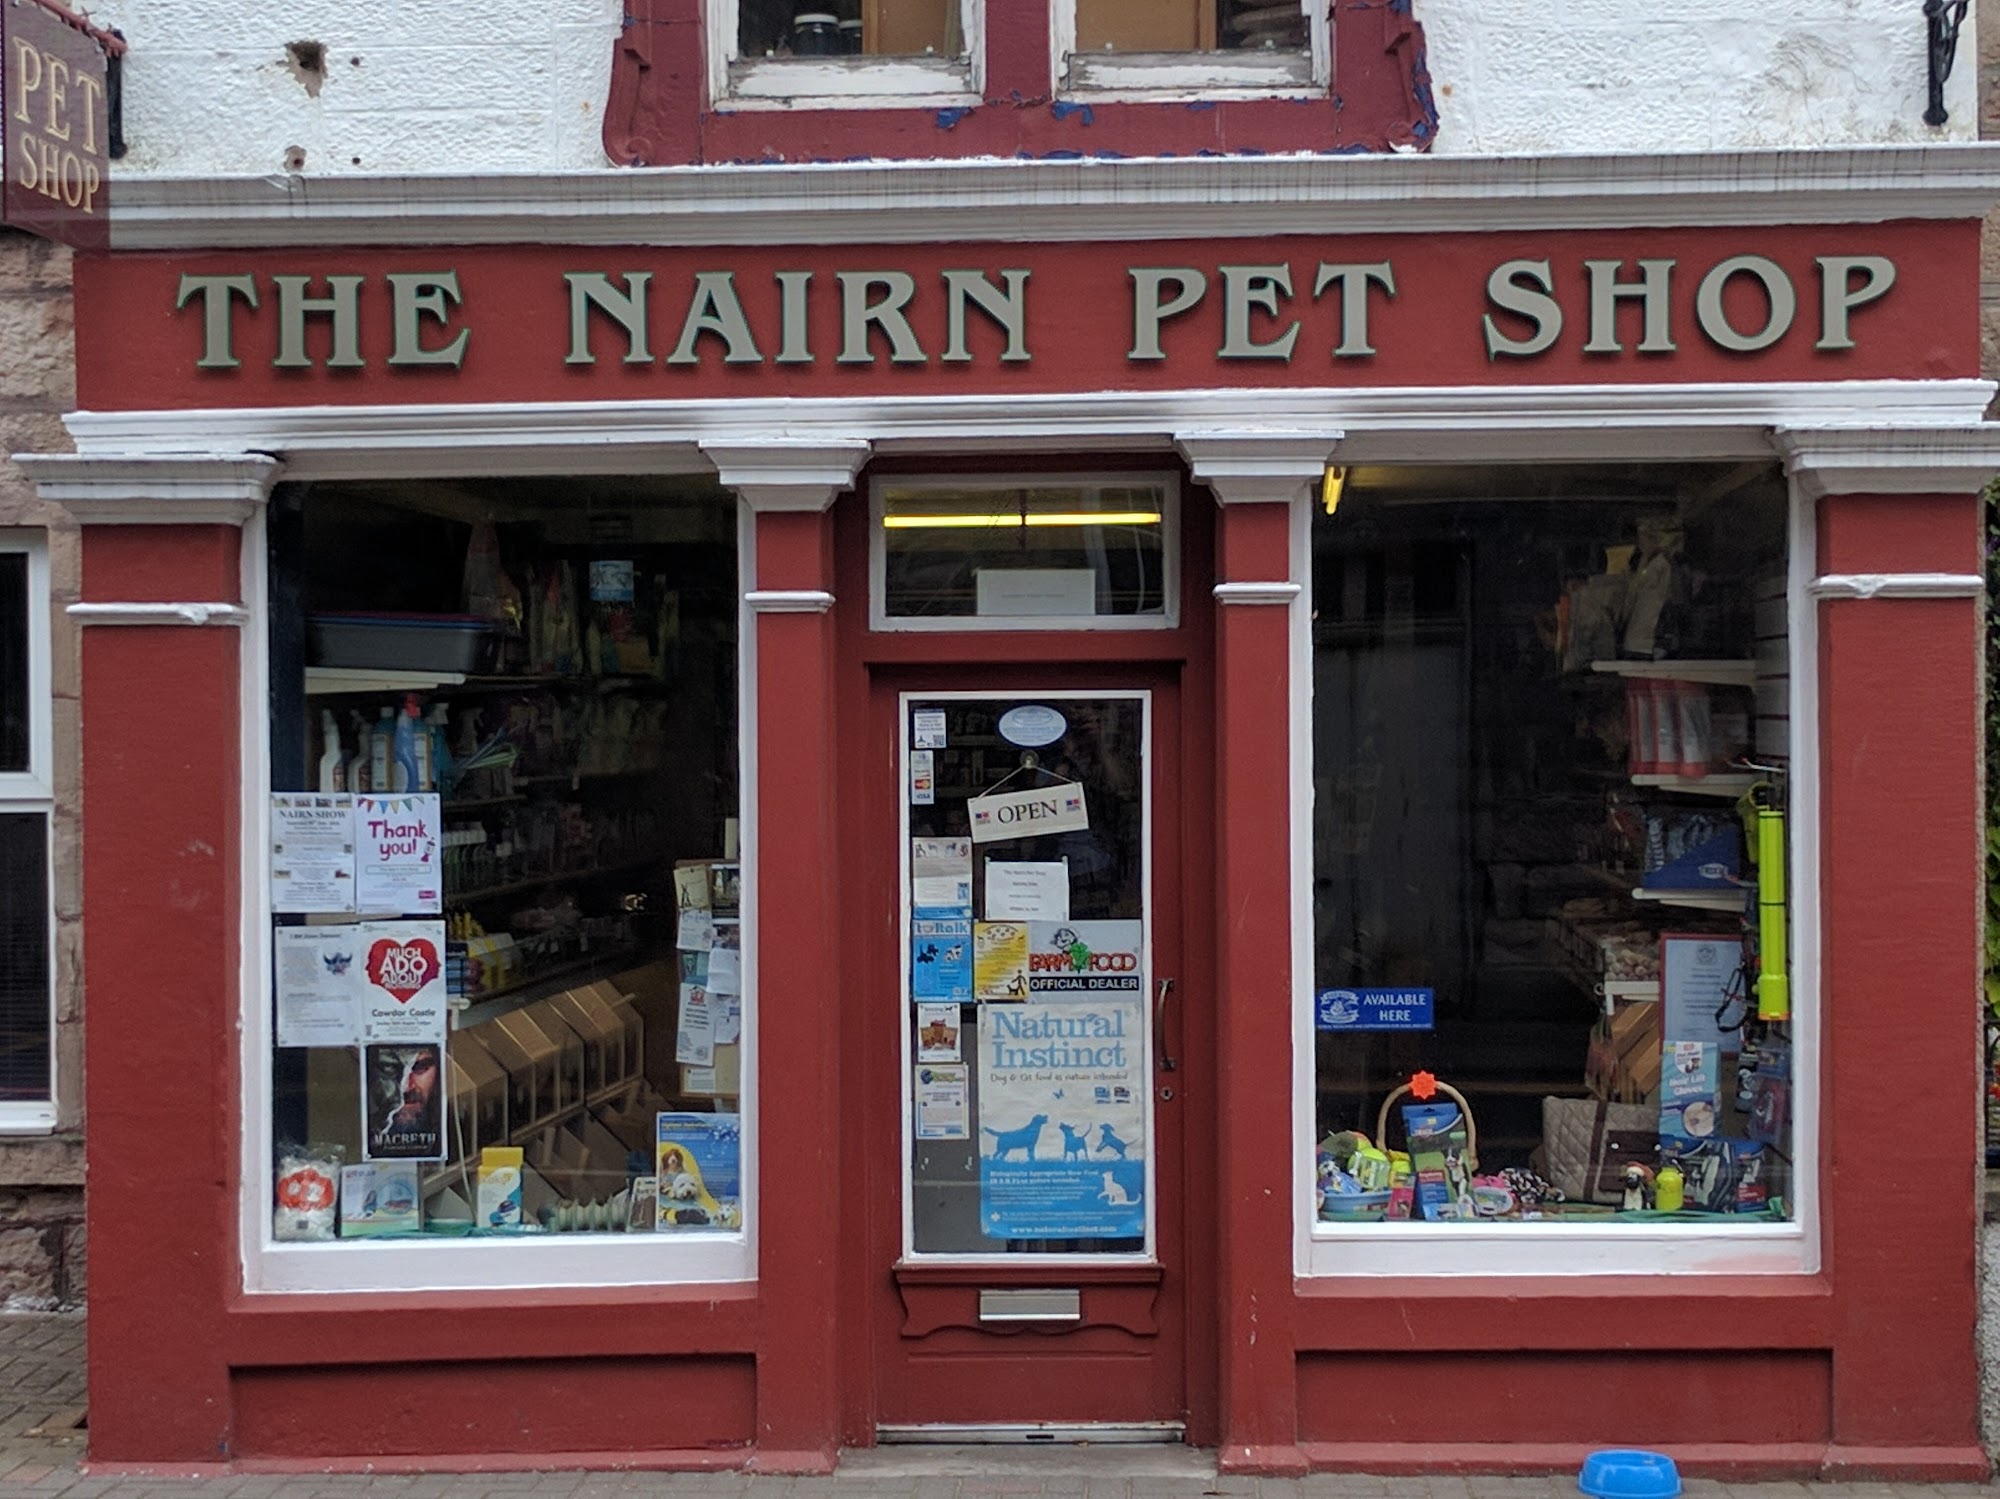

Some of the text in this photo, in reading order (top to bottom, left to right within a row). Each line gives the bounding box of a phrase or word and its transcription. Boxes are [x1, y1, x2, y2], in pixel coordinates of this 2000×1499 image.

[13, 36, 101, 155] PET
[20, 132, 99, 215] SHOP
[176, 254, 1897, 369] THE NAIRN PET SHOP
[279, 810, 346, 818] NAIRN SHOW
[997, 800, 1058, 824] OPEN
[368, 819, 428, 838] Thank
[380, 838, 417, 861] you!
[387, 947, 421, 958] MUCH
[380, 956, 428, 976] ADO
[1029, 953, 1137, 972] FARM FOOD
[381, 972, 422, 985] ABOUT
[1030, 978, 1137, 990] OFFICIAL DEALER
[1363, 994, 1427, 1006] AVAILABLE
[372, 1007, 436, 1017] Cawdor Castle
[1379, 1010, 1412, 1021] HERE
[992, 1009, 1126, 1039] Natural
[992, 1040, 1127, 1068] Instinct
[990, 1073, 1008, 1086] Dog
[1009, 1073, 1017, 1081] &
[1035, 1072, 1053, 1081] food
[375, 1133, 436, 1145] MACBETH
